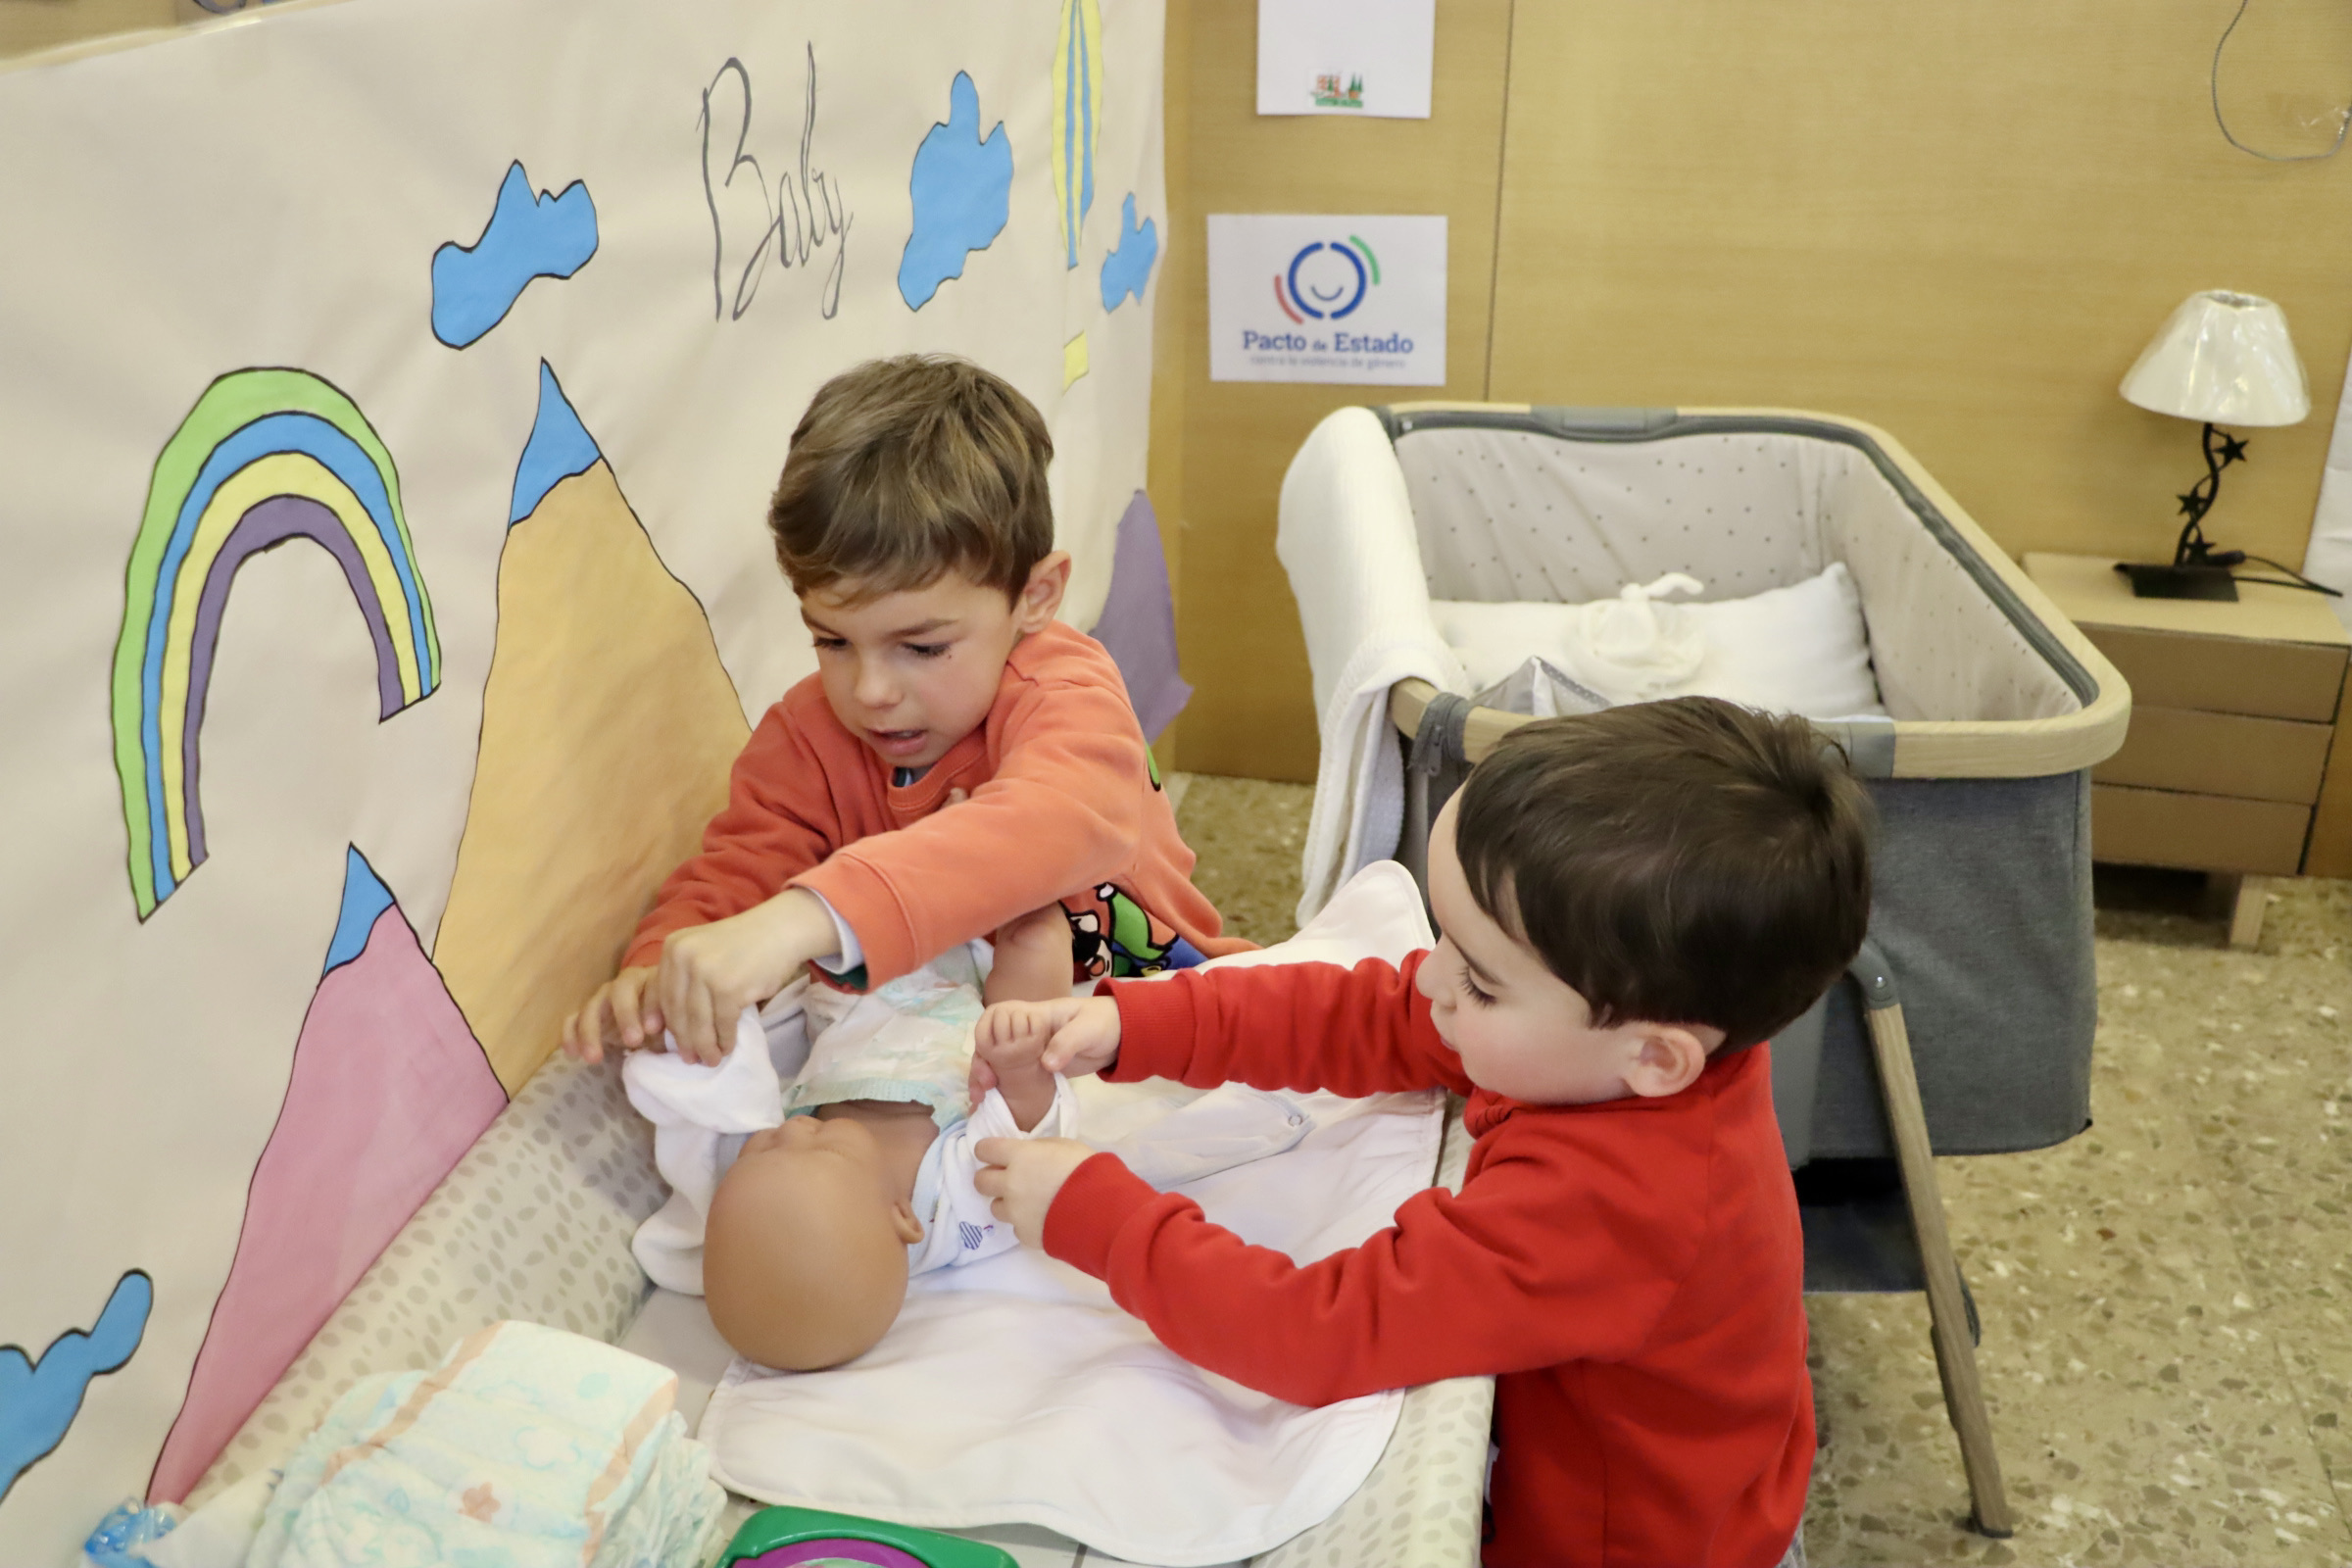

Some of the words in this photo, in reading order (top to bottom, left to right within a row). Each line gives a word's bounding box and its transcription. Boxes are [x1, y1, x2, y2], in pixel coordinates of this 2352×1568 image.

[695, 40, 854, 322] Baby
[1243, 330, 1307, 351] Pacto
[1312, 339, 1327, 351] de
[1335, 332, 1413, 353] Estado
